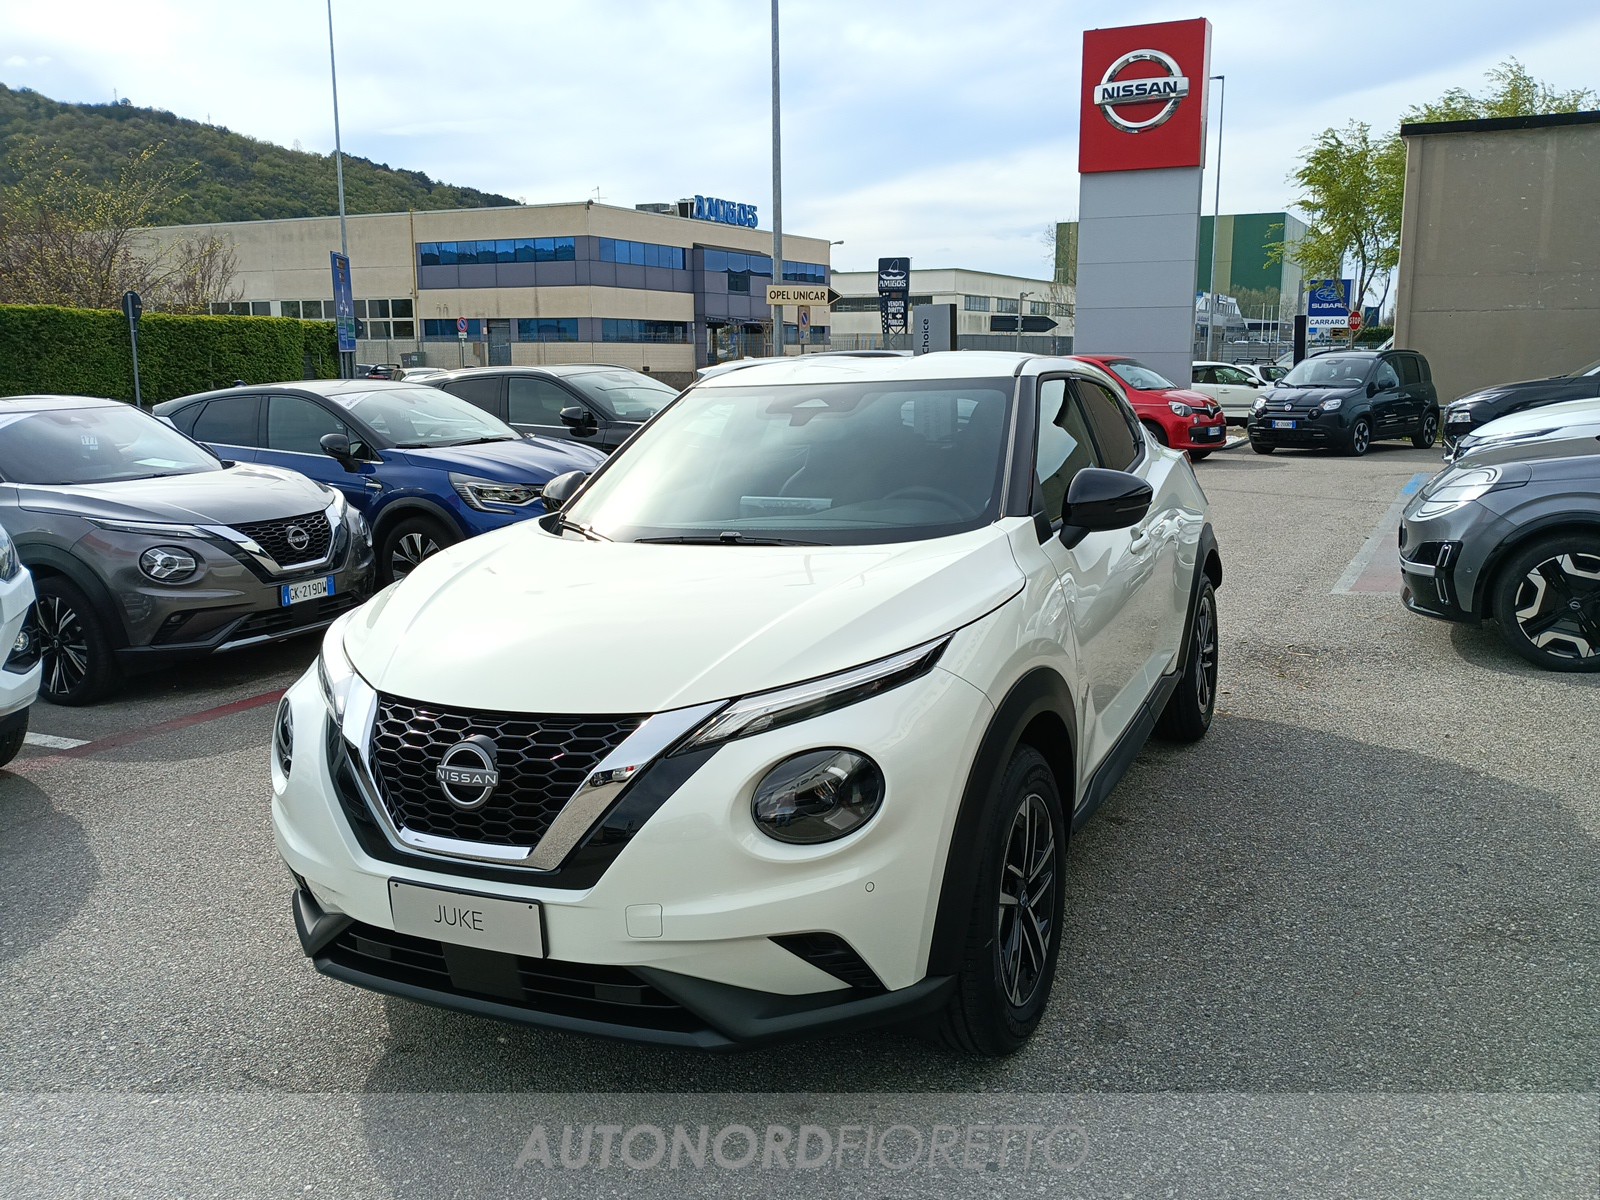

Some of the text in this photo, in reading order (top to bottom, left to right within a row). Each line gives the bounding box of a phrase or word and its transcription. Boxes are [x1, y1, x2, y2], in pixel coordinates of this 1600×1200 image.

[1102, 81, 1178, 100] NISSAN
[693, 194, 758, 229] AMIGOS
[769, 290, 826, 301] OPEL UNICAR
[1350, 317, 1361, 325] STOP
[287, 534, 310, 544] NISSAN
[436, 767, 498, 786] NISSAN
[433, 903, 485, 932] JUKE
